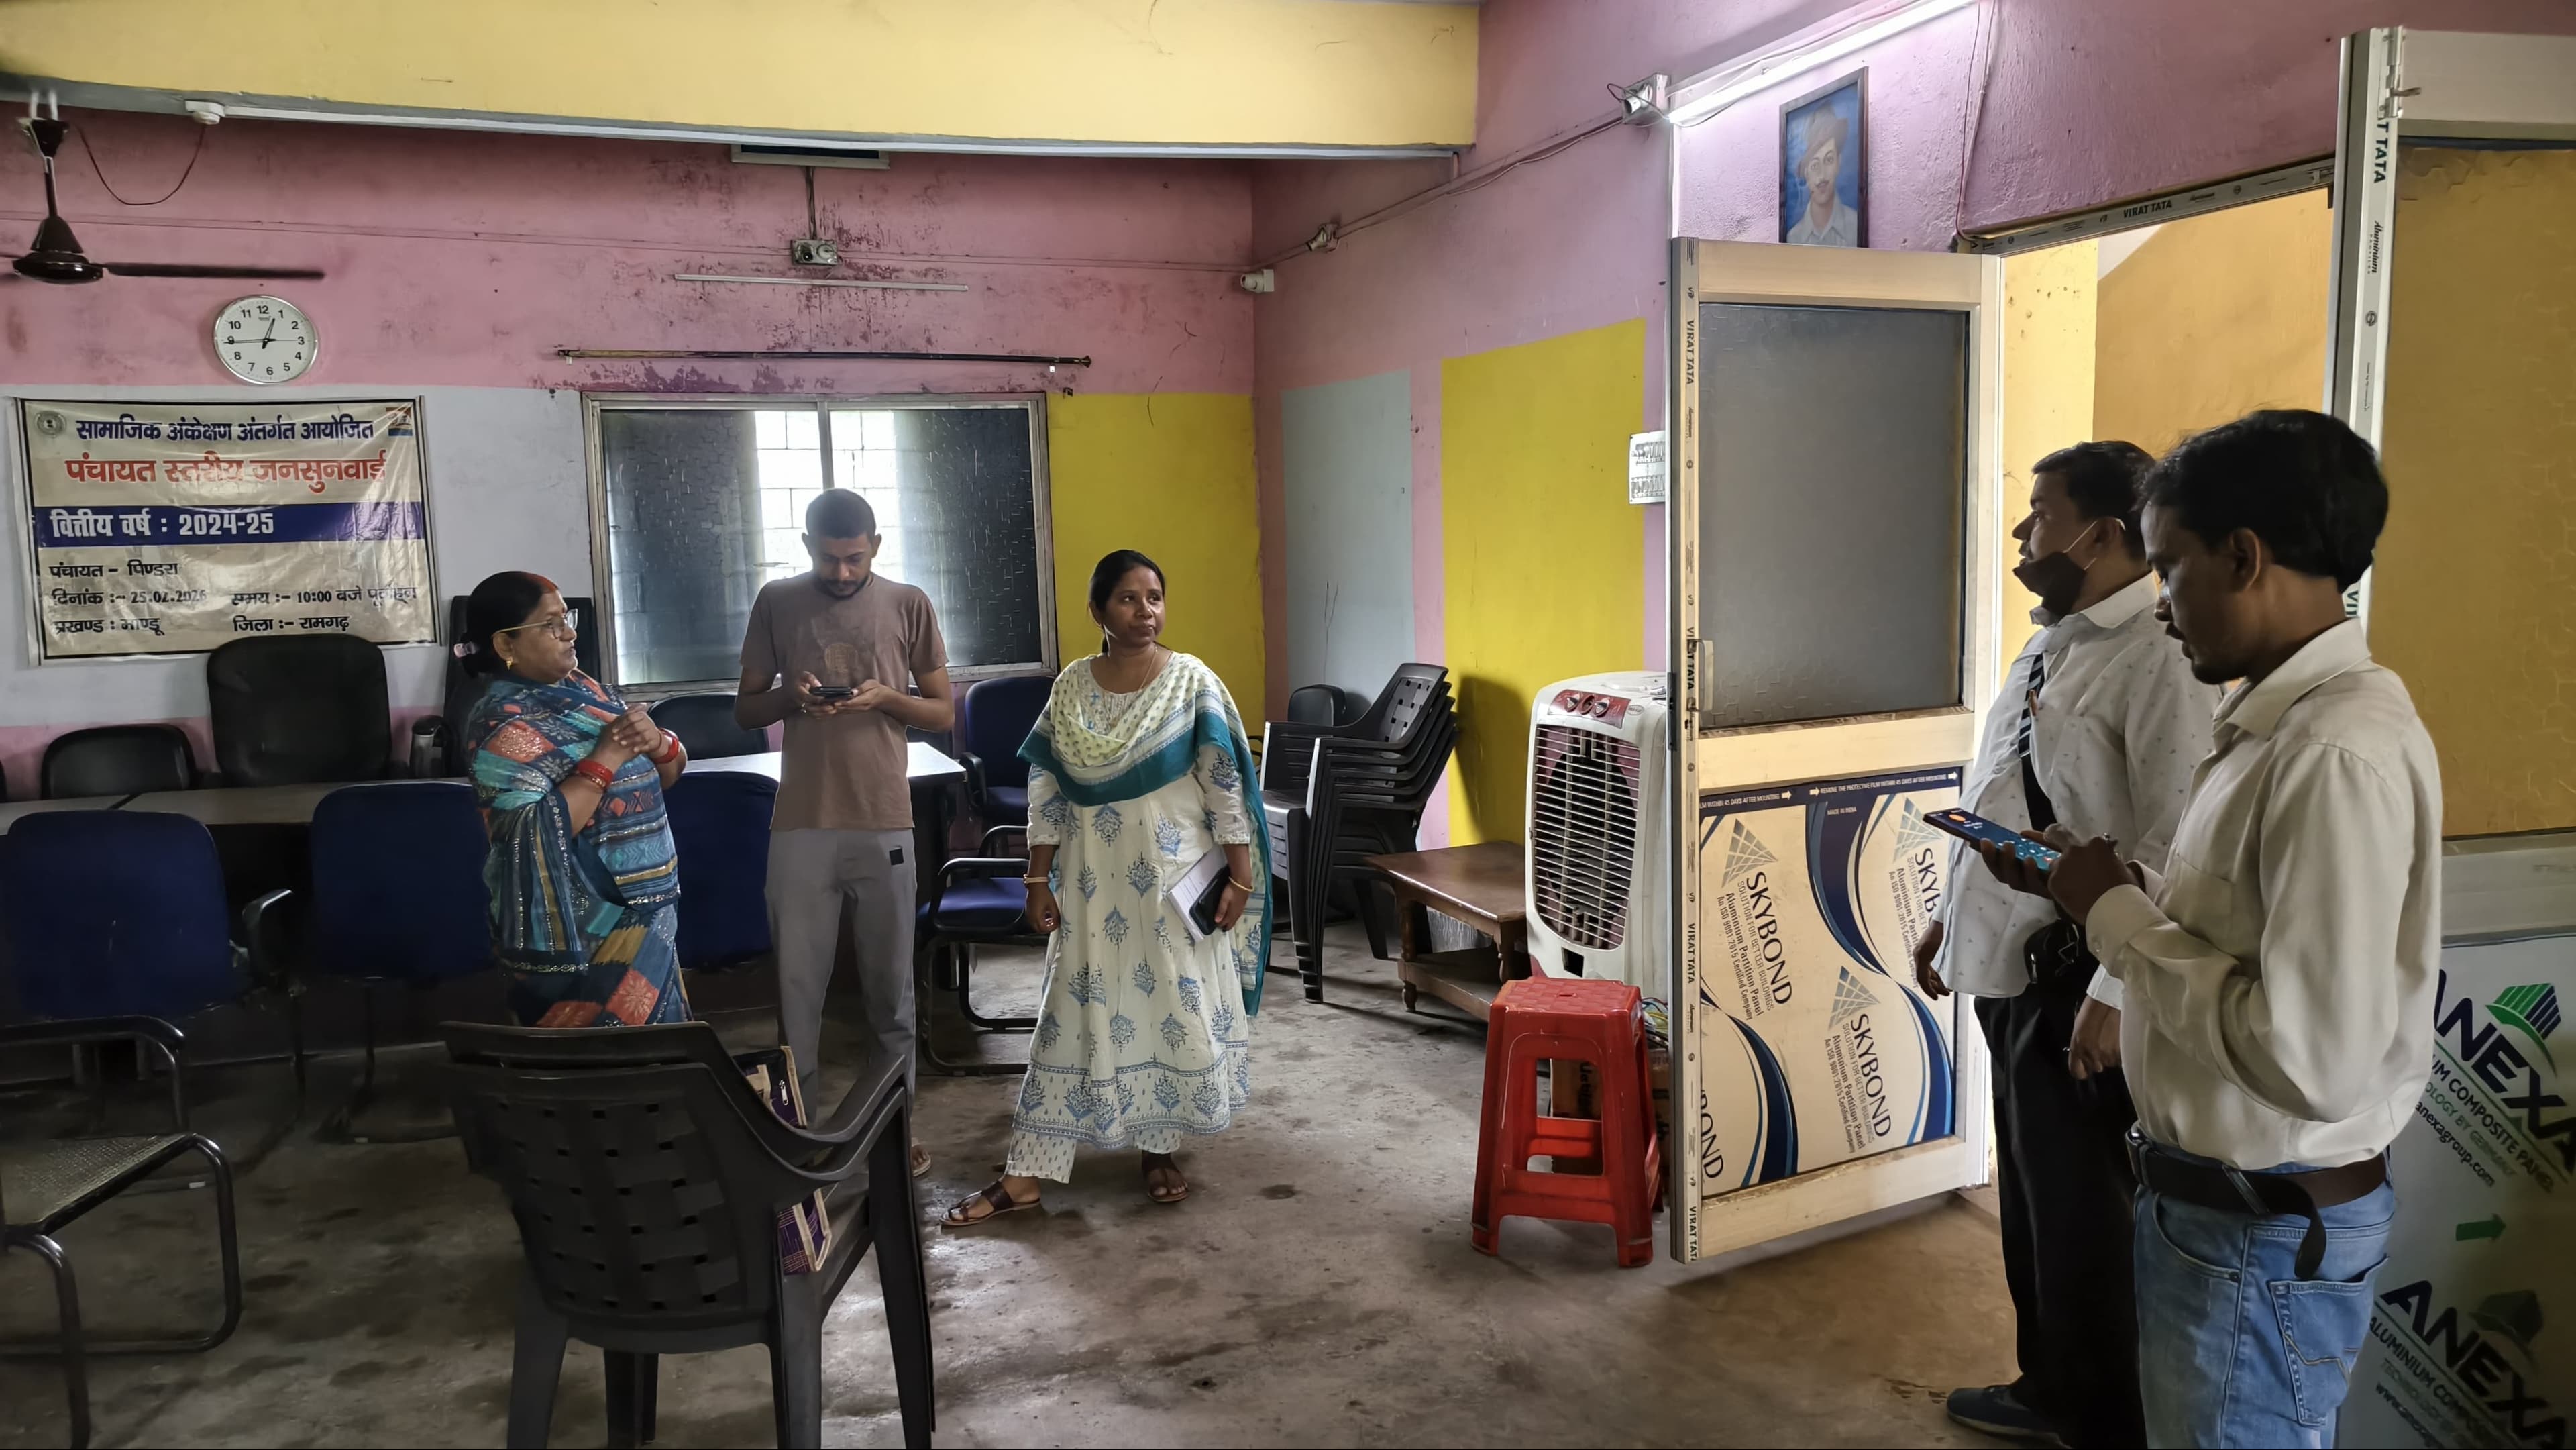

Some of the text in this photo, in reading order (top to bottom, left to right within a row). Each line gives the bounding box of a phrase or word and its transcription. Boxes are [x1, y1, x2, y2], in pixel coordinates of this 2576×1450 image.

[2373, 138, 2388, 184] TATA
[2123, 200, 2173, 219] VIRAT TATA
[241, 309, 252, 318] 11
[256, 305, 269, 315] 12
[278, 309, 284, 319] 1
[228, 321, 241, 330] 10
[291, 321, 299, 330] 2
[1686, 320, 1695, 354] VIRAT
[227, 335, 235, 345] 9
[297, 336, 305, 346] 3
[234, 351, 241, 360] 8
[248, 362, 255, 372] 7
[283, 362, 290, 372] 5
[294, 351, 302, 360] 4
[266, 366, 274, 376] 6
[1686, 356, 1695, 385] TATA
[75, 413, 373, 441] सामाजिक अंकेक्षण अंतर्गत आयोजित
[64, 449, 386, 494] पंचायत स्तरीय जनसुनवाई
[50, 508, 113, 537] वित्तीय
[119, 508, 152, 537] वर्ष
[178, 513, 274, 535] 2024-25
[49, 562, 104, 578] पंचायत
[127, 559, 178, 576] पिण्डरा
[52, 588, 104, 605] दिनांक
[229, 592, 270, 605] समय
[297, 590, 332, 603] 10:00
[53, 619, 104, 634] प्रखण्ड
[233, 615, 274, 632] जिला
[299, 616, 350, 632] रामगढ़
[1686, 627, 1695, 661] VIT
[1686, 663, 1695, 690] TATA
[1896, 867, 1912, 916] Aluminium
[1915, 847, 1941, 926] SKYB
[1717, 896, 1725, 907] An
[1720, 906, 1728, 920] ISO
[1918, 909, 1928, 931] BETT
[1687, 923, 1696, 955] VIRAT
[1737, 880, 1775, 1011] SOLUTION FOR BETTER BUILDINGS
[1746, 871, 1792, 1004] SKYBOND
[1725, 892, 1765, 1017] Aluminium Partition Panel
[1687, 957, 1696, 984] TATA
[1842, 1023, 1857, 1062] SOLUTION
[1851, 1060, 1860, 1076] FOR
[1851, 1013, 1892, 1137] SKYBOND
[1832, 1034, 1866, 1149] Aluminium Partition Panel
[1854, 1076, 1867, 1106] BETTER
[2448, 1078, 2519, 1155] COMPOSITE
[2455, 1115, 2471, 1131] BY
[2415, 1101, 2496, 1188] anexagroup.com
[1689, 1206, 1697, 1237] VIRAT
[2369, 1316, 2436, 1388] ALUMINIUM
